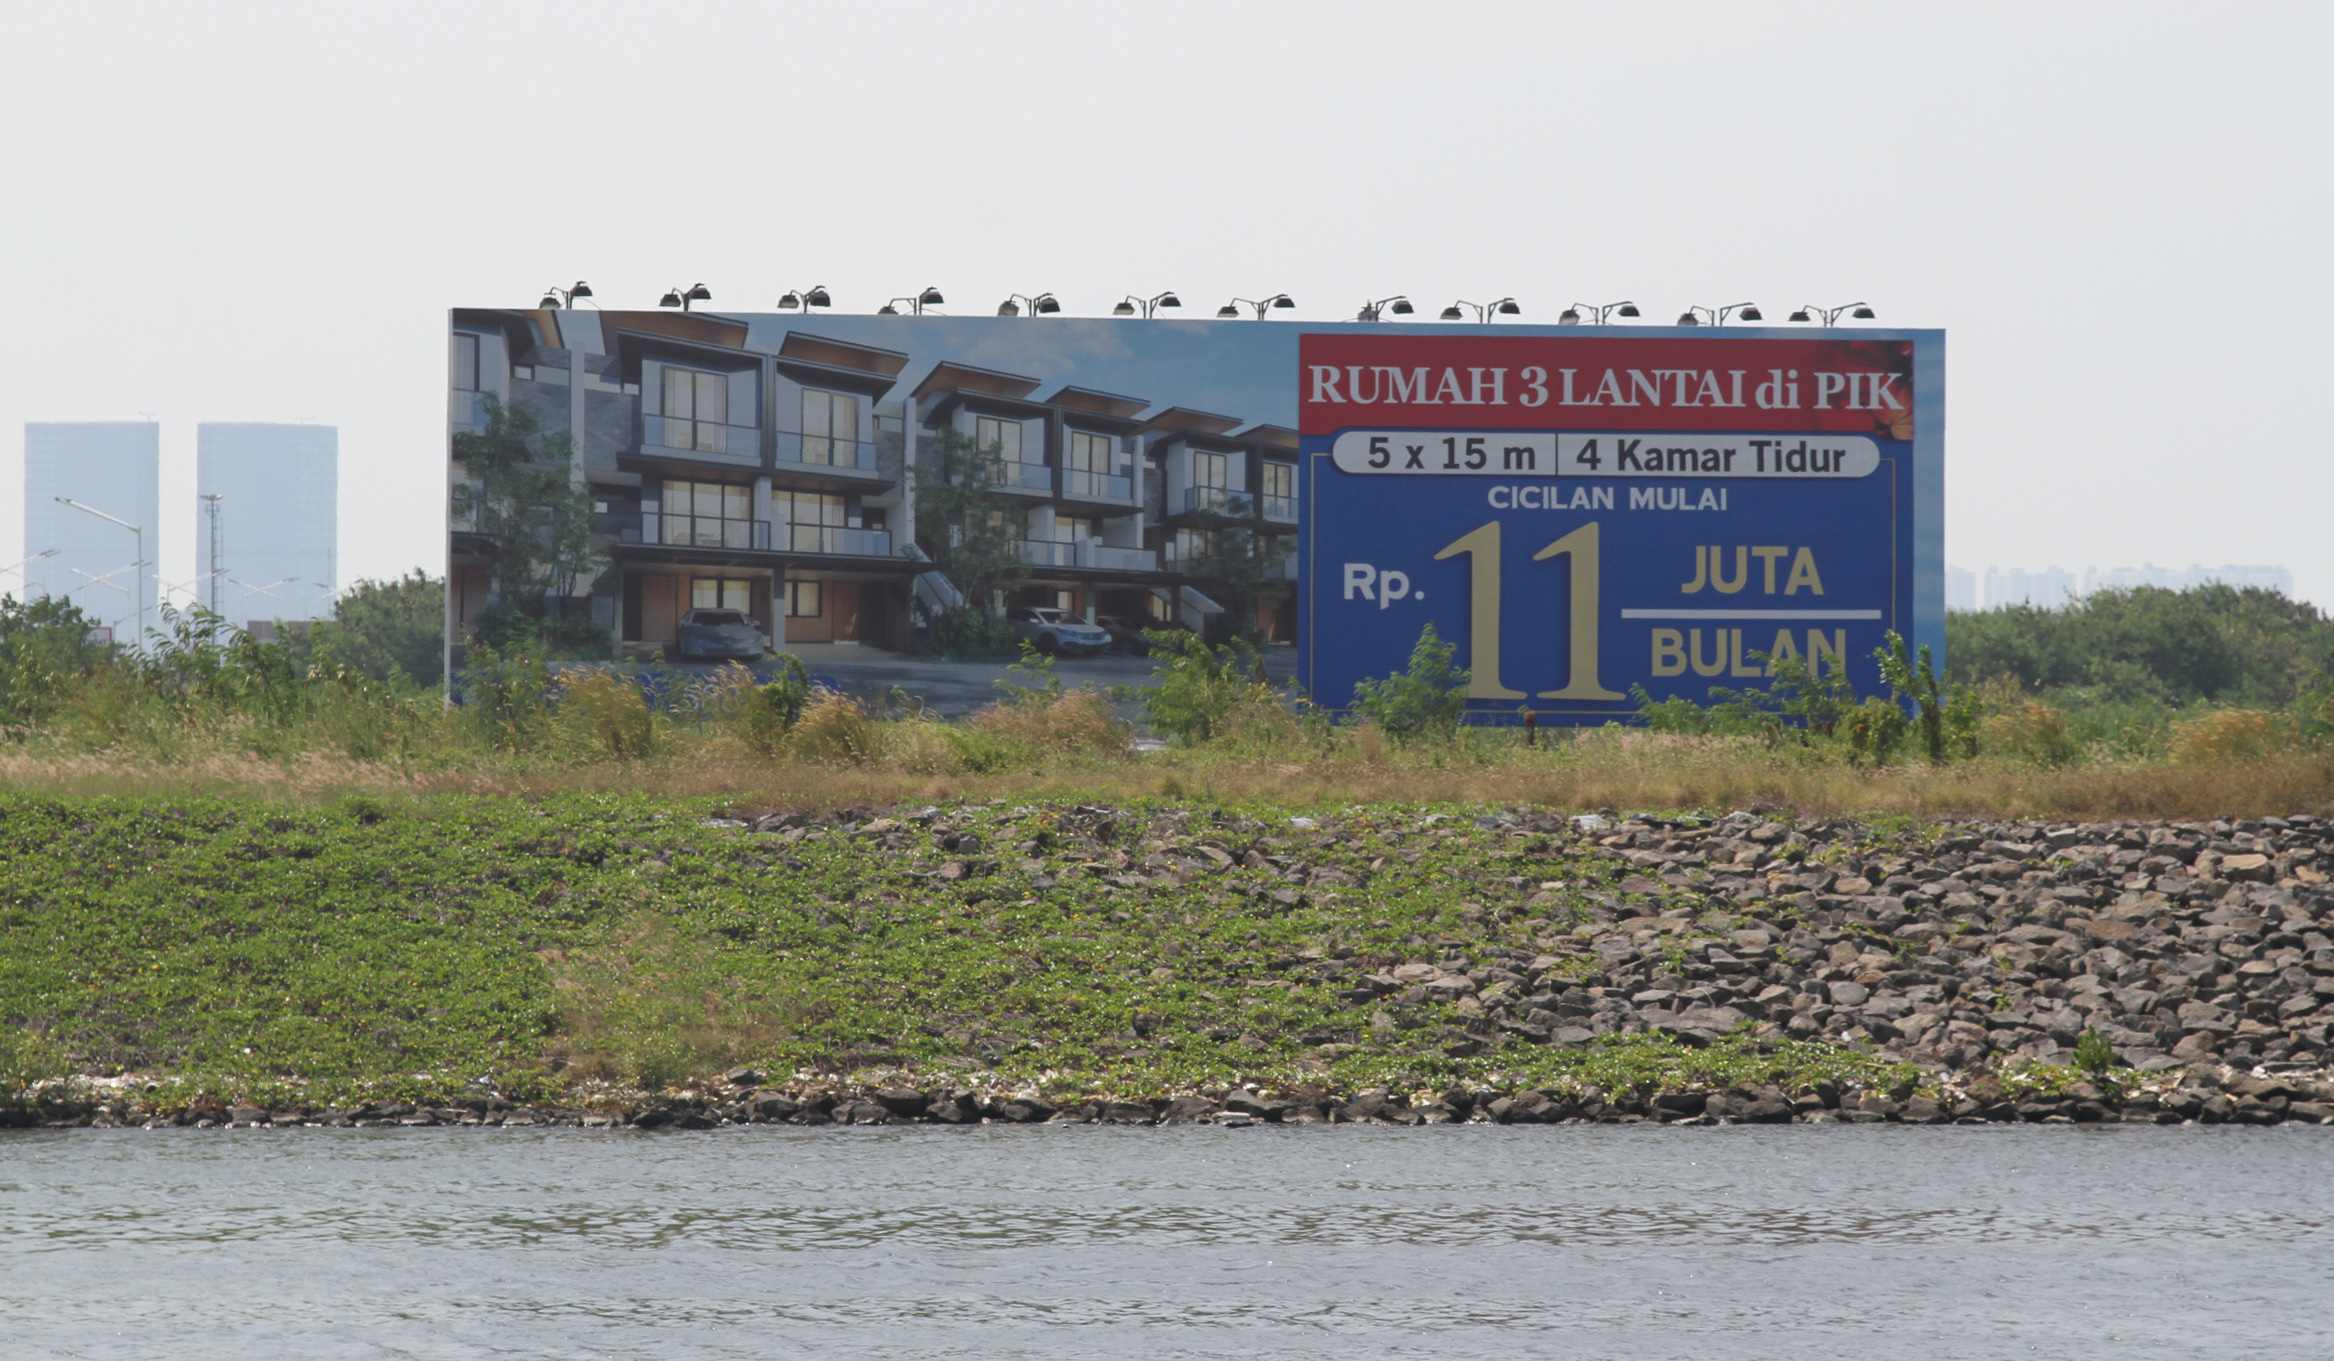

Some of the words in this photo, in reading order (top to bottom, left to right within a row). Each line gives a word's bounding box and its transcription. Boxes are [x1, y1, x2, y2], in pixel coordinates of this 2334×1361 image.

[1308, 365, 1508, 405] RUMAH
[1519, 366, 1549, 407] 3
[1558, 368, 1747, 407] LANTAI
[1755, 368, 1801, 410] di
[1813, 372, 1905, 411] PIK
[1367, 436, 1391, 469] 5
[1404, 445, 1424, 470] x
[1442, 437, 1487, 470] 15
[1503, 446, 1536, 471] m
[1576, 438, 1602, 471] 4
[1617, 439, 1736, 473] Kamar
[1749, 440, 1846, 473] Tidur
[1487, 485, 1614, 510] CICILAN
[1629, 487, 1728, 511] MULAI
[1681, 545, 1825, 595] JUTA
[1343, 562, 1425, 610] Rp.
[1433, 520, 1627, 701] 11
[1651, 628, 1846, 677] BULAN
